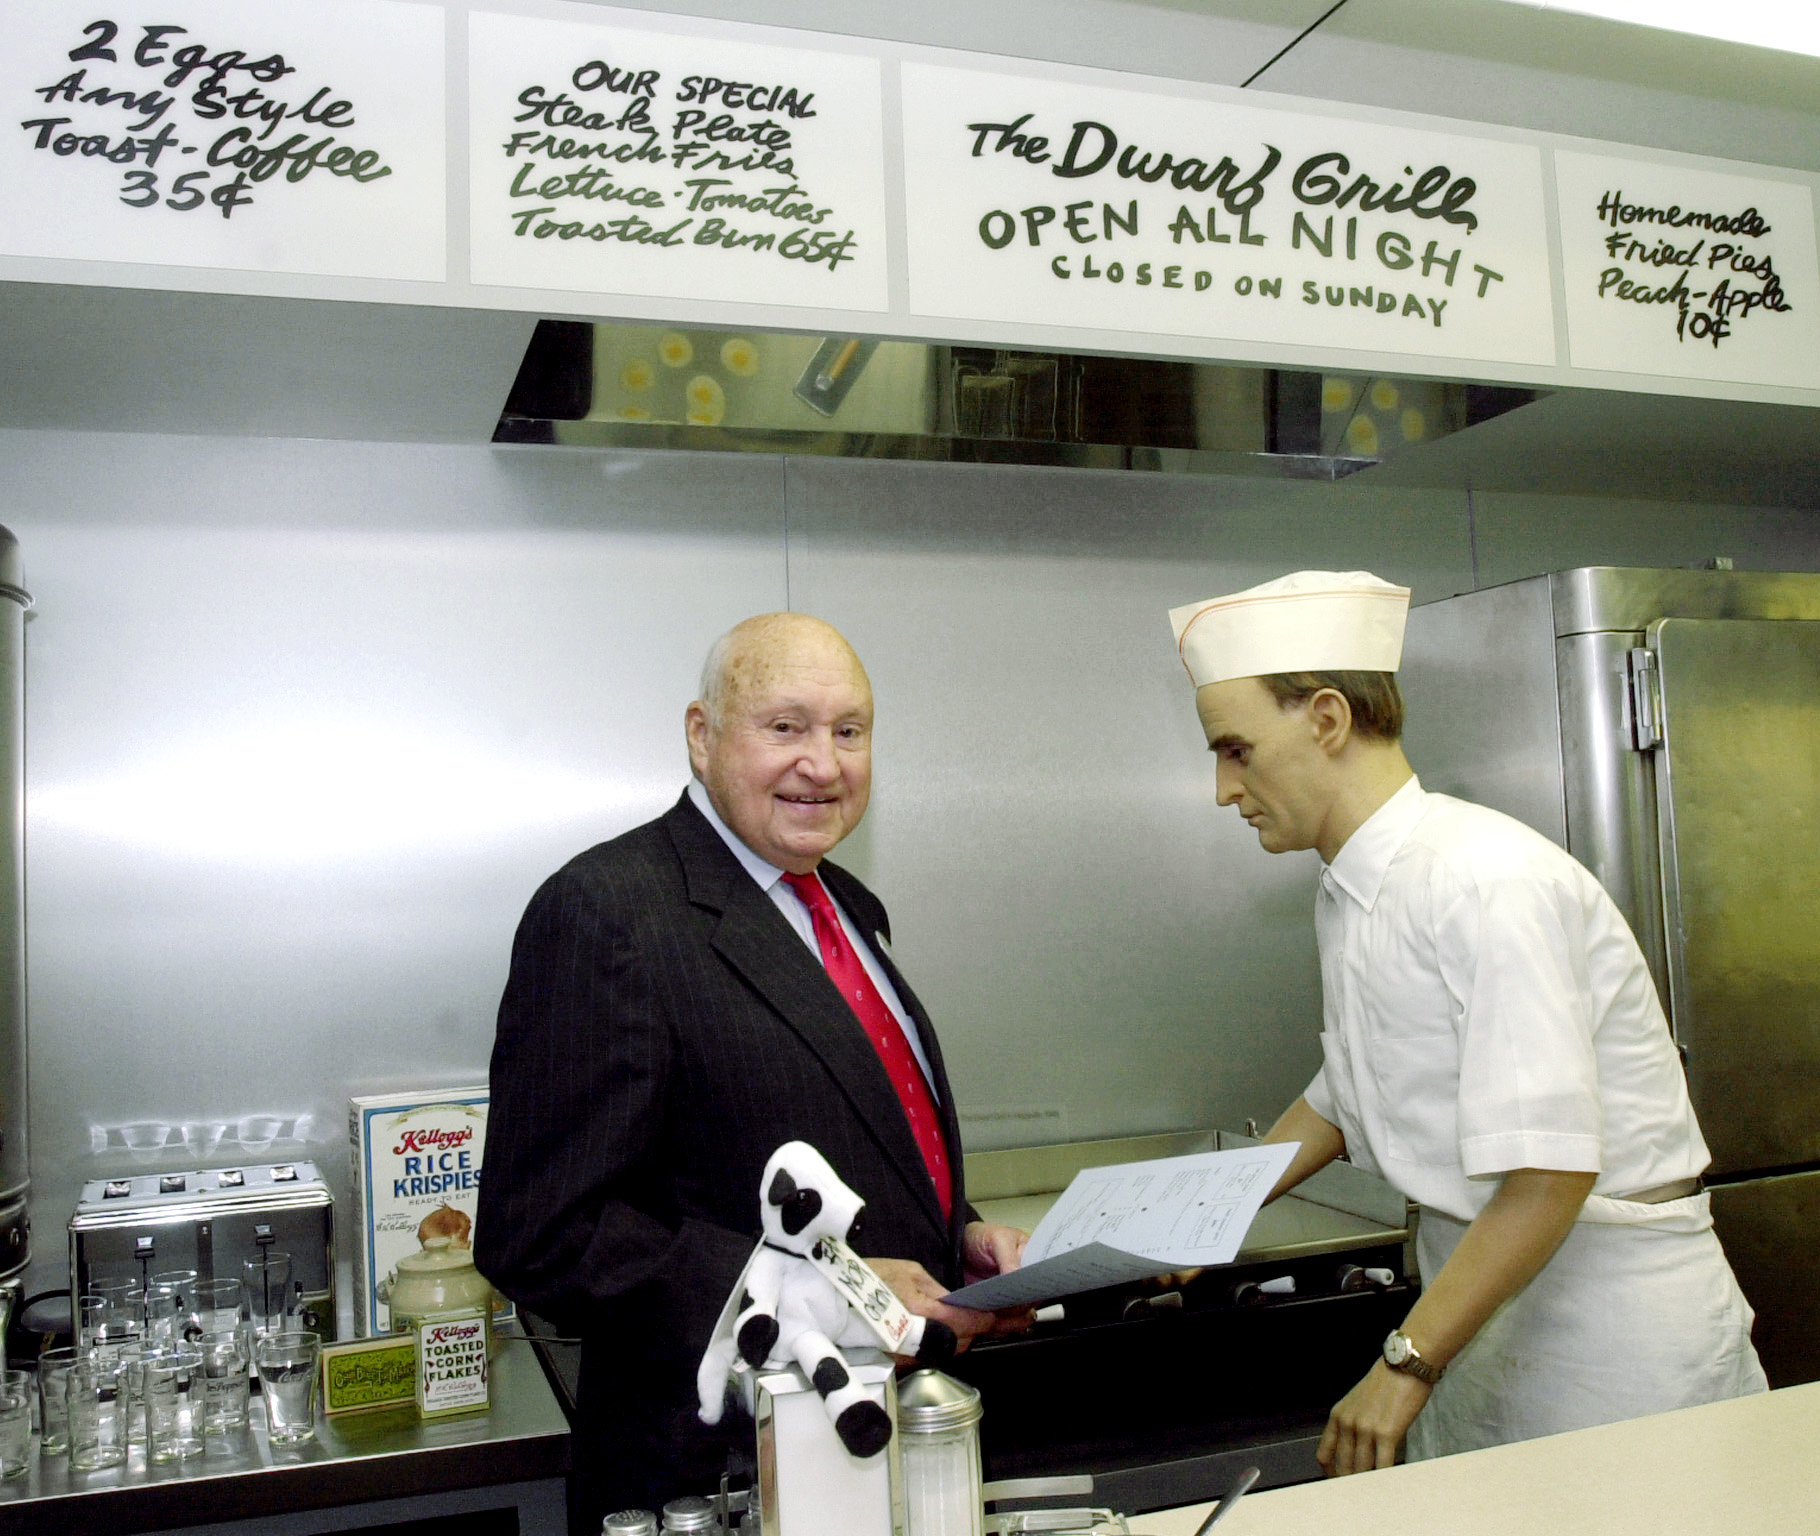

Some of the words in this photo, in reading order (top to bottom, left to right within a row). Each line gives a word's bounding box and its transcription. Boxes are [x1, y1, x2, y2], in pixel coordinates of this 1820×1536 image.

[68, 20, 118, 62] 2
[134, 25, 296, 90] Eggs
[35, 69, 176, 131] Any
[192, 85, 355, 140] Style
[572, 60, 660, 98] OUR
[676, 75, 817, 120] SPECIAL
[514, 86, 656, 134] Steak
[672, 110, 791, 152] Plate
[966, 114, 1052, 165] The
[1051, 121, 1282, 216] Dwarf
[512, 207, 694, 248] Toasted
[1597, 190, 1771, 238] Homemade
[979, 199, 1139, 249] OPEN
[1168, 204, 1268, 247] ALL
[1291, 211, 1504, 298] NIGHT
[1605, 231, 1705, 267] Fried
[1708, 243, 1775, 280] Pies
[1051, 255, 1213, 291] CLOSED
[1235, 275, 1283, 299] ON
[1302, 280, 1448, 328] SUNDAY
[393, 1125, 473, 1155] Kellogg's
[405, 1150, 472, 1176] RICE
[393, 1169, 482, 1198] KRISPIES
[424, 1340, 484, 1357] TOASTED
[436, 1354, 474, 1368] CORN
[429, 1365, 480, 1381] FLAKES
